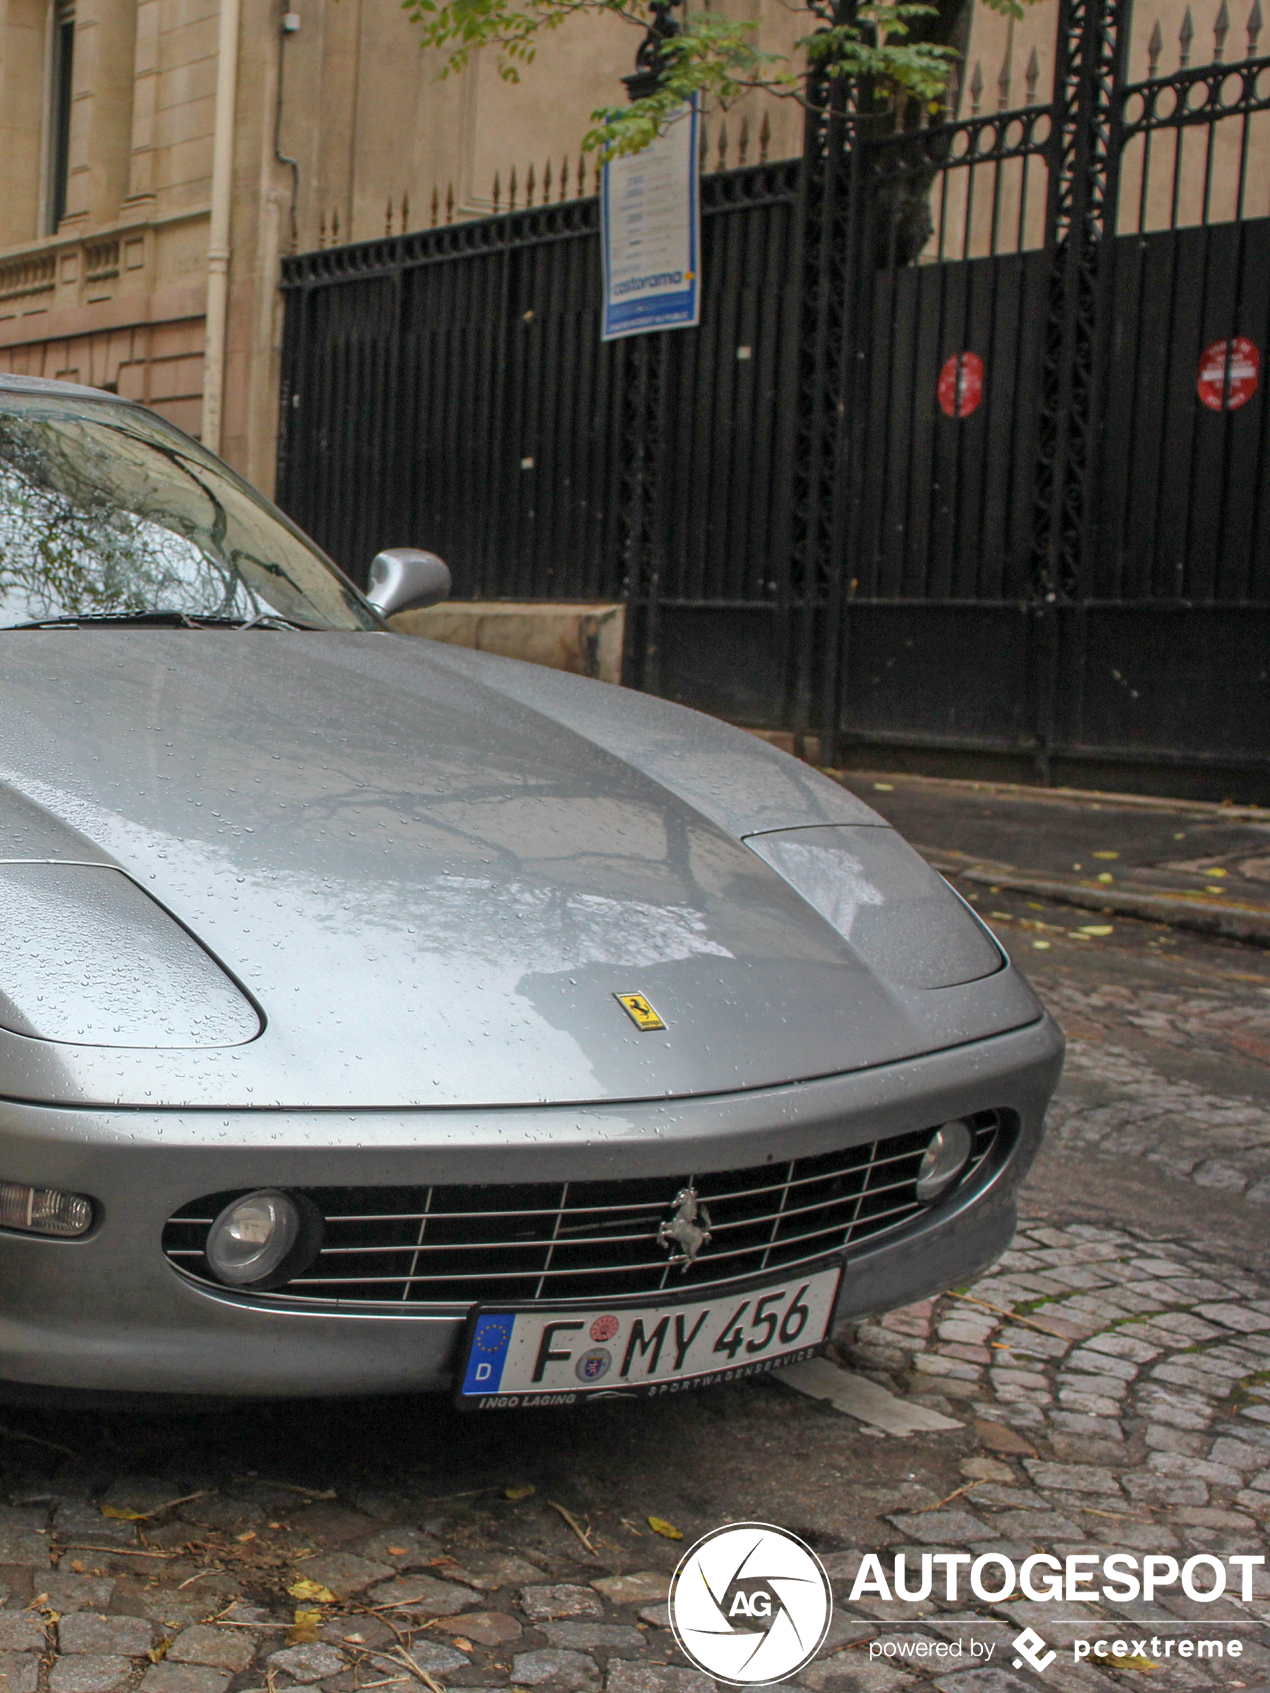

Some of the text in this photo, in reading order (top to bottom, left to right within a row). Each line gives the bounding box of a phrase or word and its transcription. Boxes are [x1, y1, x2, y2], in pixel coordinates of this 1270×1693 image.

[532, 1283, 811, 1383] F MY 456
[475, 1363, 492, 1381] D
[648, 1349, 814, 1397] SPORTWAGENSERVICE
[479, 1394, 577, 1409] INGO LAGING
